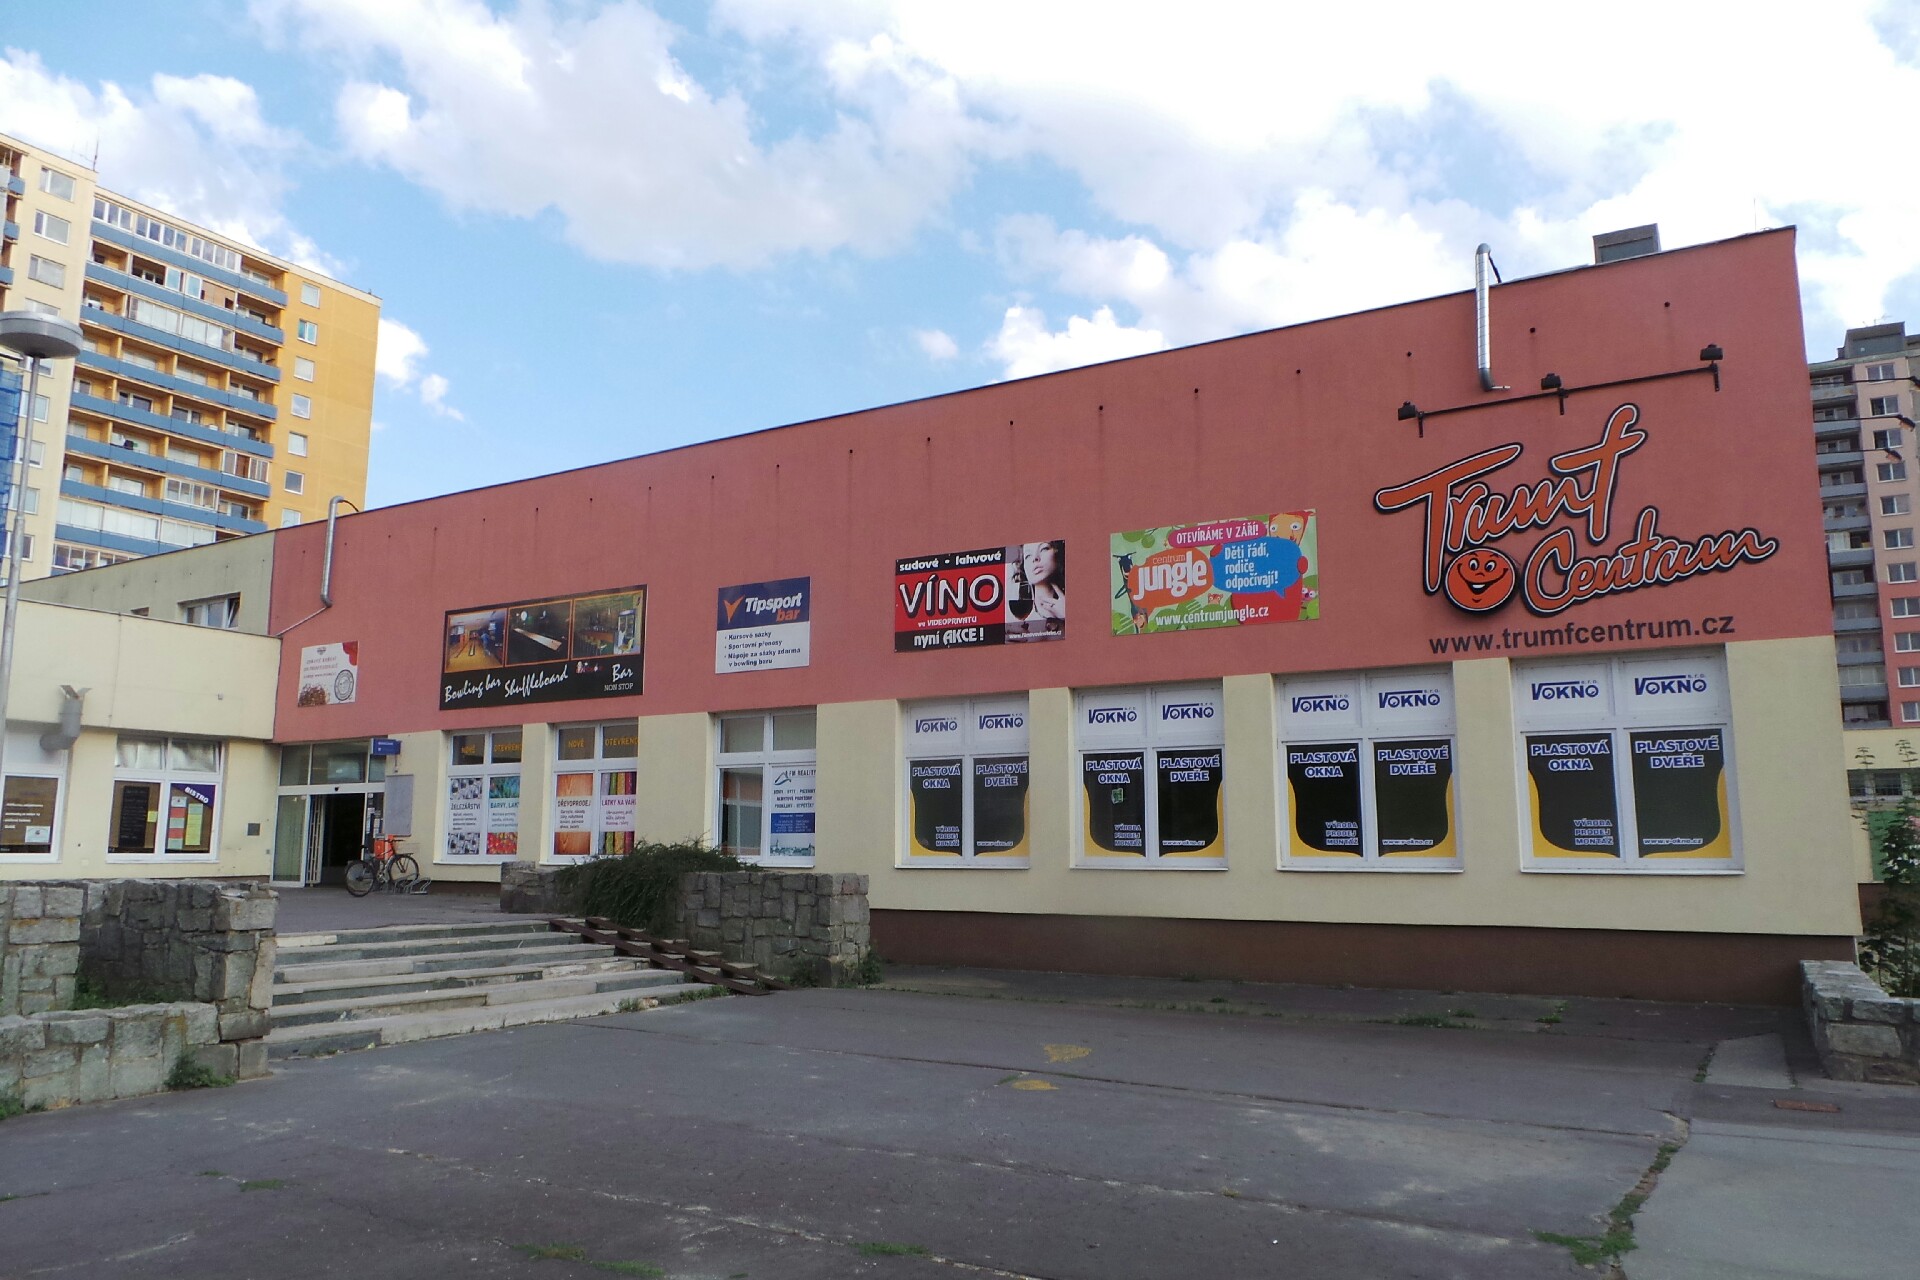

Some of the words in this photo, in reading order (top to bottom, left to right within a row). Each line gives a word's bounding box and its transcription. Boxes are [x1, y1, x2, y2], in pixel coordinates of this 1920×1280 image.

[1373, 403, 1648, 596] Trumf
[1176, 529, 1224, 544] OTEVÍRÁME
[1226, 528, 1233, 539] V
[1235, 523, 1259, 537] ZÁŘÍ!
[1152, 554, 1186, 565] centrum
[1224, 547, 1245, 560] Děti
[1247, 543, 1269, 558] řádí,
[899, 558, 939, 572] sudové
[955, 551, 1002, 566] lahvové
[1225, 561, 1255, 574] rodiče
[1519, 507, 1780, 617] Centrum
[1133, 551, 1207, 601] jungle
[1225, 571, 1279, 591] odpočívají!
[745, 592, 803, 615] Tipsport
[899, 574, 1003, 617] VÍNO
[775, 609, 801, 622] bar
[1155, 605, 1269, 626] www.centrumjungle.cz
[914, 632, 940, 649] nyní
[1429, 616, 1735, 654] www.trumfcentrum.cz
[504, 664, 569, 698] Shuffleboard
[612, 663, 634, 682] Bar
[444, 681, 484, 703] Bowling
[485, 674, 501, 691] bar
[604, 683, 617, 691] NON
[618, 682, 633, 691] STOP
[1531, 681, 1599, 701] VOKNO
[1634, 675, 1707, 696] VOKNO
[1292, 695, 1350, 713] VOKNO
[1378, 690, 1440, 709] VOKNO
[1088, 707, 1138, 724] VOKNO
[1162, 703, 1214, 720] VOKNO
[915, 717, 957, 734] VOKNO
[979, 714, 1024, 730] VOKNO
[1377, 745, 1449, 761] PLASTOVÉ
[1531, 739, 1610, 756] PLASTOVÁ
[1635, 735, 1719, 754] PLASTOVÉ
[1086, 757, 1142, 771] PLASTOVÁ
[1160, 754, 1220, 769] PLASTOVÉ
[1290, 748, 1357, 764] PLASTOVÁ
[1650, 753, 1705, 769] DVEŘE
[912, 764, 961, 777] PLASTOVÁ
[976, 761, 1028, 774] PLASTOVÉ
[1305, 766, 1343, 778] OKNA
[1389, 761, 1436, 775] DVEŘE
[1548, 758, 1594, 772] OKNA
[922, 778, 950, 789] OKNA
[985, 774, 1018, 787] DVEŘE
[1098, 773, 1130, 784] OKNA
[1170, 769, 1210, 782] DVEŘE
[184, 786, 209, 804] BISTRO
[1574, 828, 1611, 836] PRODEJ
